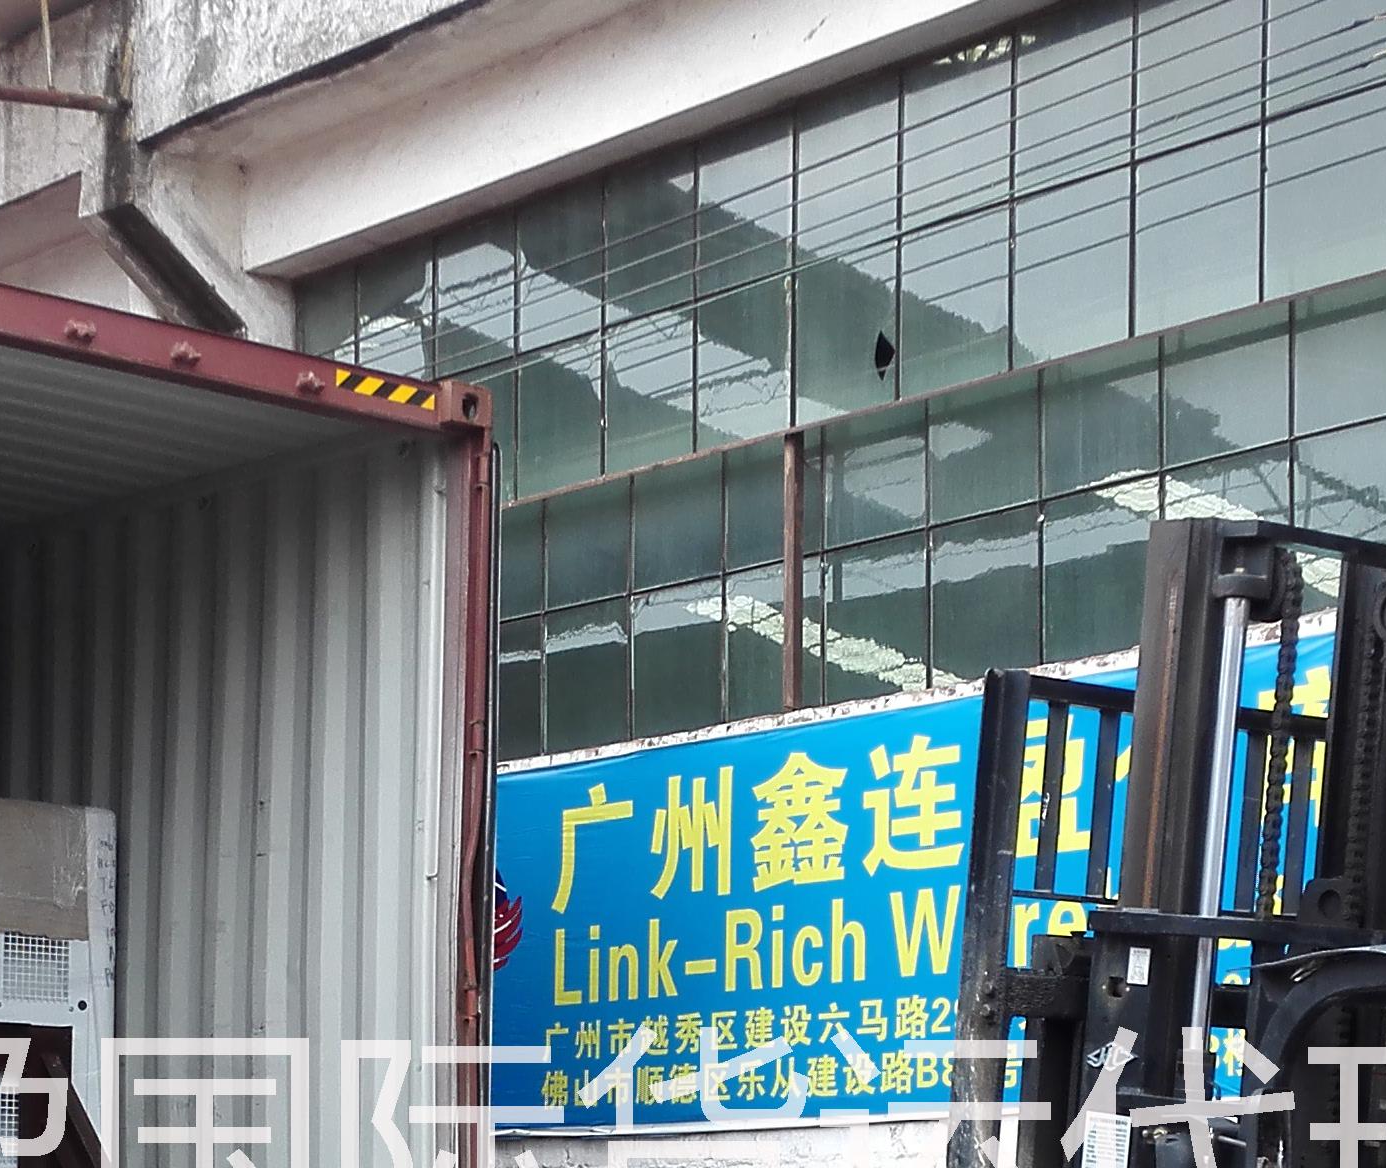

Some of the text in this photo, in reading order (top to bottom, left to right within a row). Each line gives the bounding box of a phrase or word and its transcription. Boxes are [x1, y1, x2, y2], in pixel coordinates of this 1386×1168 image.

[554, 898, 866, 1006] Link-Rich
[543, 994, 959, 1062] 广州市越秀区建设六马路2
